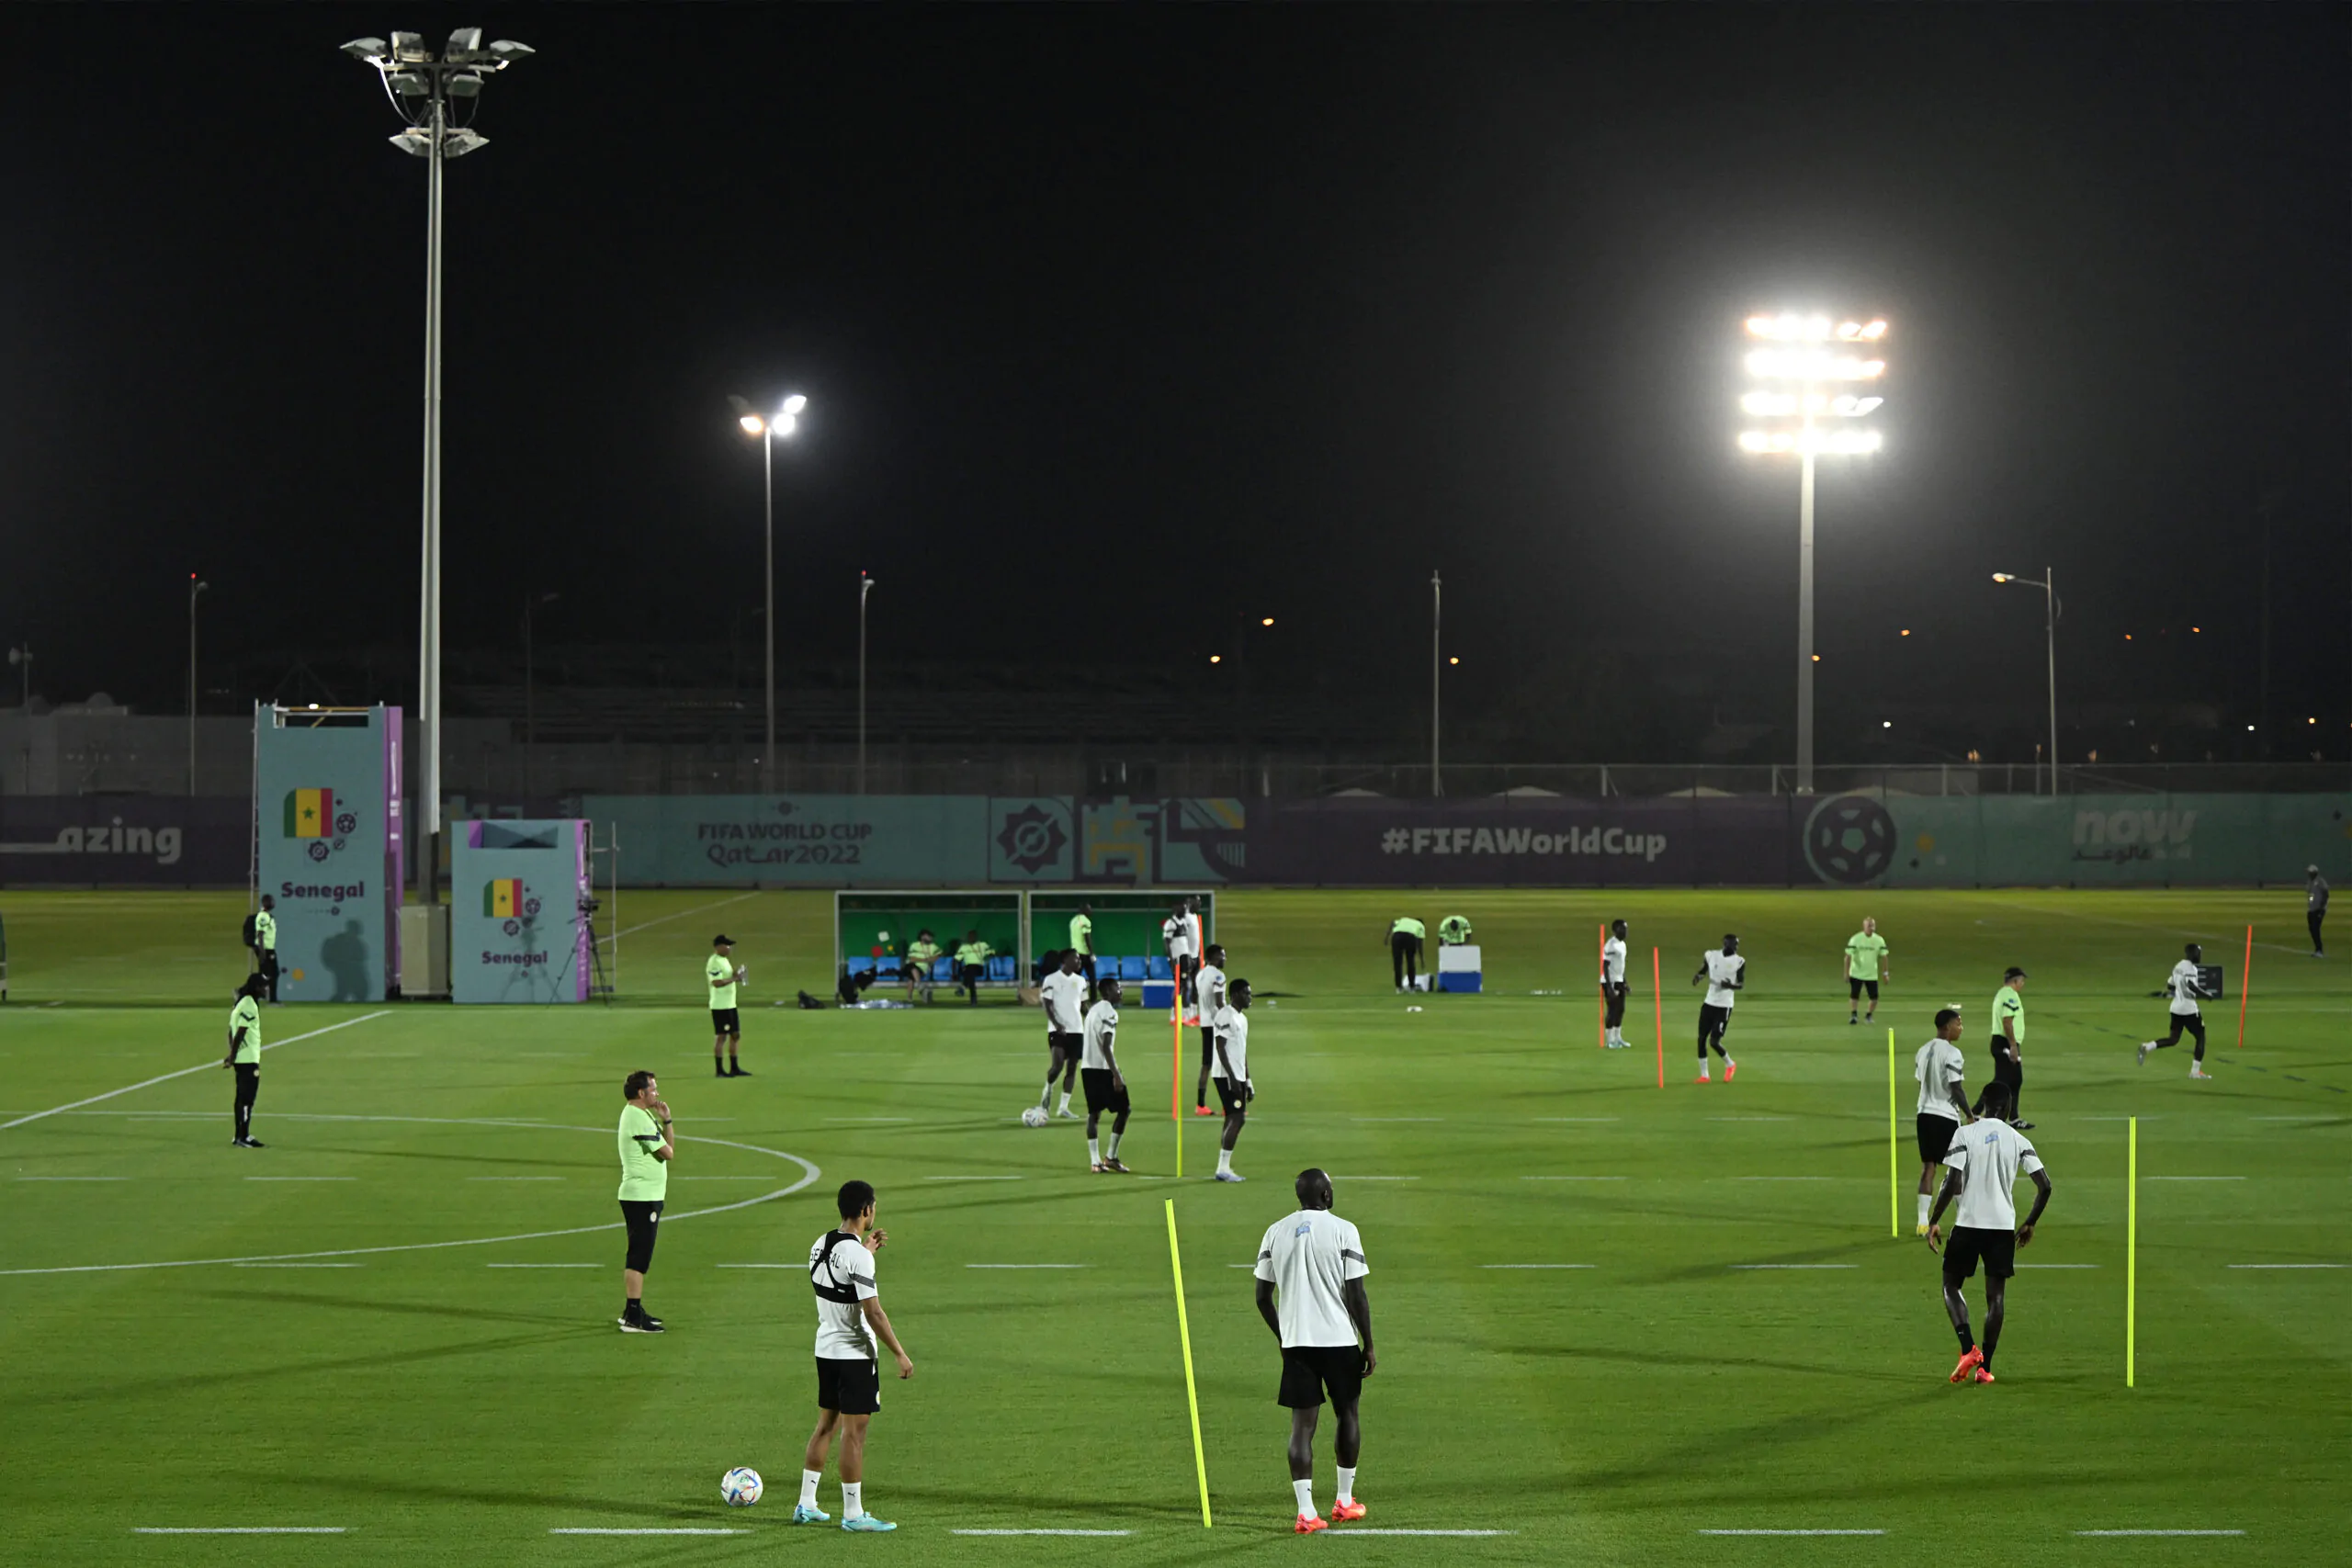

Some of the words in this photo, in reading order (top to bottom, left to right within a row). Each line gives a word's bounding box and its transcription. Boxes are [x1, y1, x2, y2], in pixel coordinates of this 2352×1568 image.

[697, 823, 743, 840] FIFA
[747, 823, 826, 840] WORLD
[831, 823, 873, 840] CUP
[2072, 810, 2198, 844] now
[1381, 826, 1668, 863] #FIFAWorldCup
[281, 881, 365, 903] Senegal
[481, 950, 548, 968] Senegal
